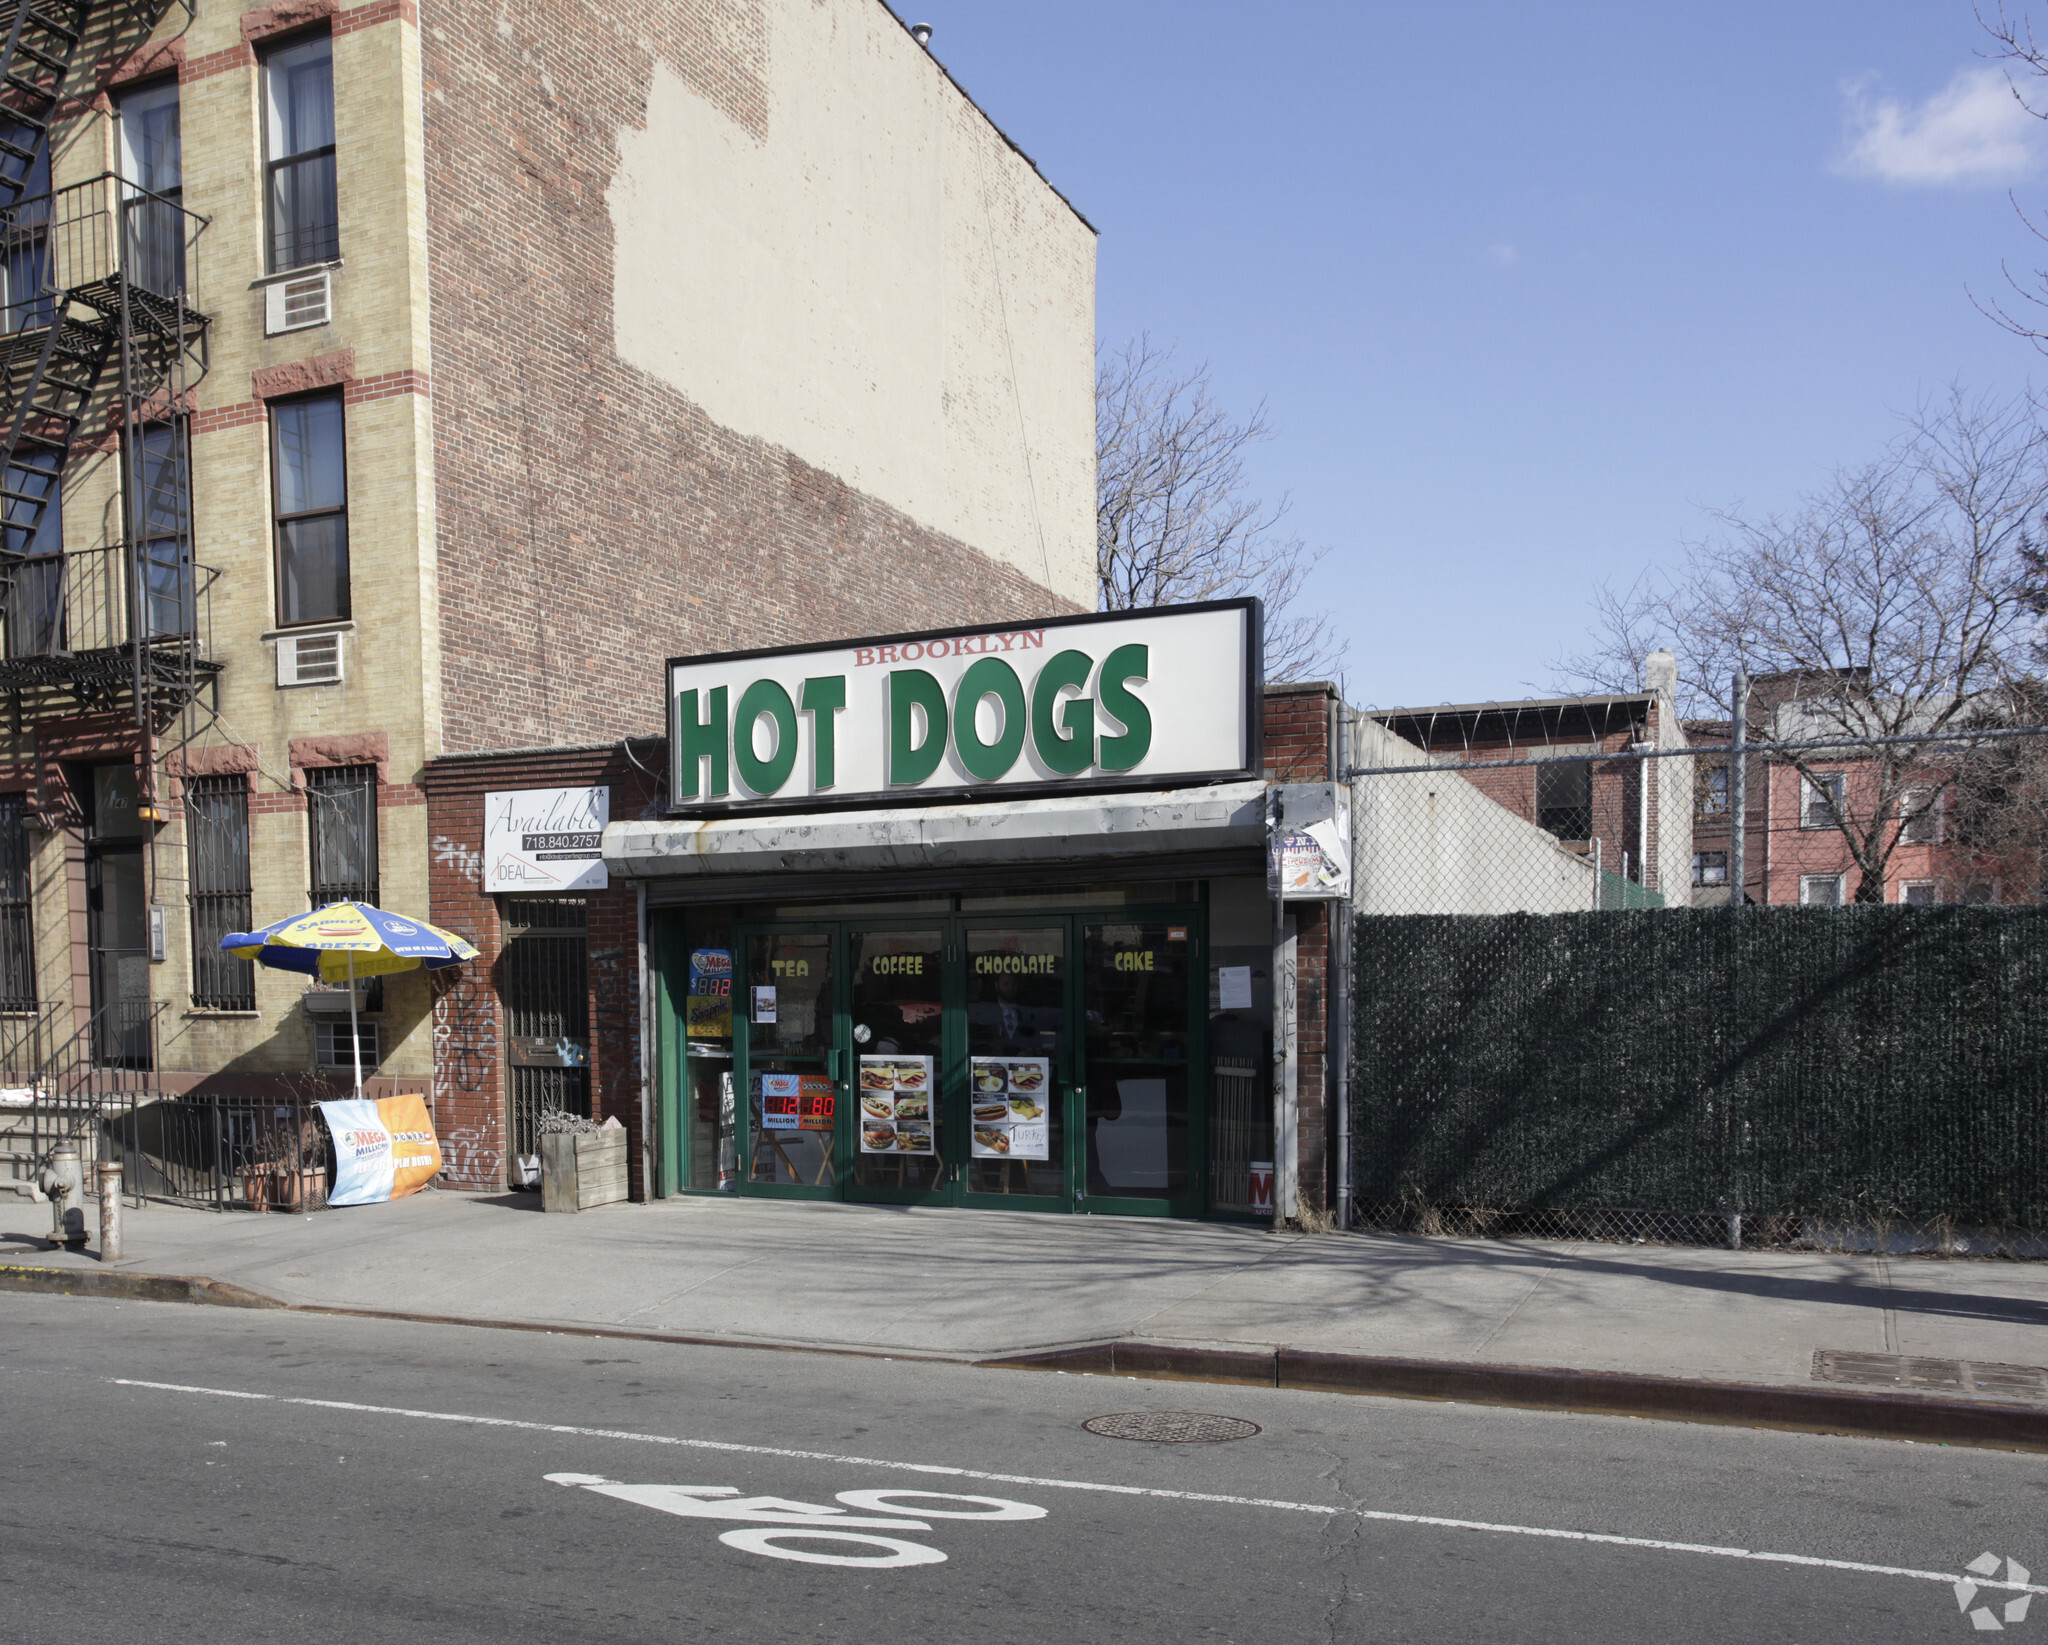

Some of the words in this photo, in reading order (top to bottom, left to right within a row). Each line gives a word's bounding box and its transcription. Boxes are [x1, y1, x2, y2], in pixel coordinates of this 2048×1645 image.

[853, 629, 1046, 667] BROOKLYN
[679, 674, 846, 799] HOT
[889, 643, 1152, 786] DOGS
[489, 790, 602, 839] Available
[525, 835, 600, 849] 718.840.2757
[705, 956, 731, 968] MEGA
[772, 960, 808, 977] TEA
[873, 956, 922, 975] COFFEE
[975, 955, 1054, 974] CHOCOLATE
[1115, 951, 1153, 971] CAKE
[691, 999, 727, 1022] Snapple
[783, 1098, 798, 1114] 12
[812, 1098, 835, 1115] 80
[354, 1131, 386, 1147] MEGA
[393, 1132, 424, 1143] POWER
